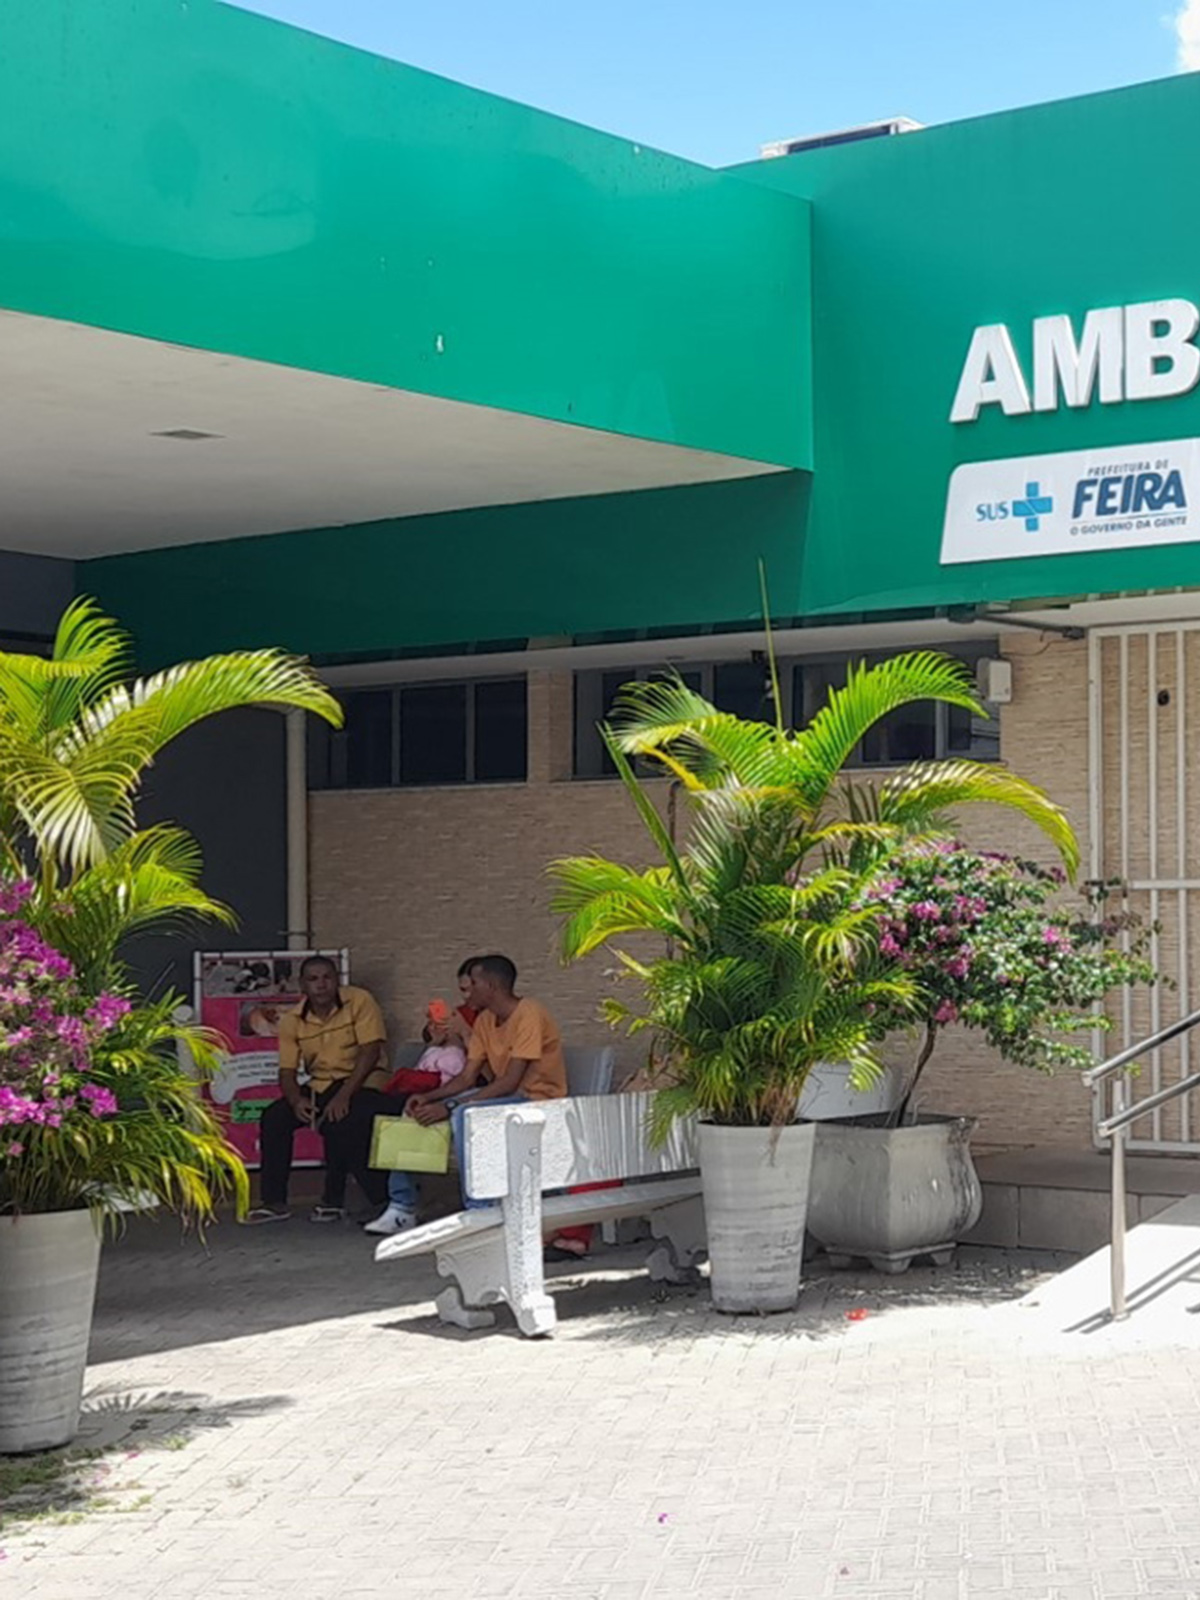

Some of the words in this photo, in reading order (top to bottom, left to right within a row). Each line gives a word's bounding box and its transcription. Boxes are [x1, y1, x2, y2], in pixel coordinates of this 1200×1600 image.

[1087, 461, 1151, 477] PREFEITURA
[1155, 459, 1169, 470] DE
[1071, 469, 1187, 519] FEIRA
[976, 501, 1009, 521] SUS
[1070, 526, 1079, 536] O
[1081, 521, 1133, 535] GOVERNO
[1136, 518, 1152, 529] DA
[1154, 516, 1187, 528] GENTE
